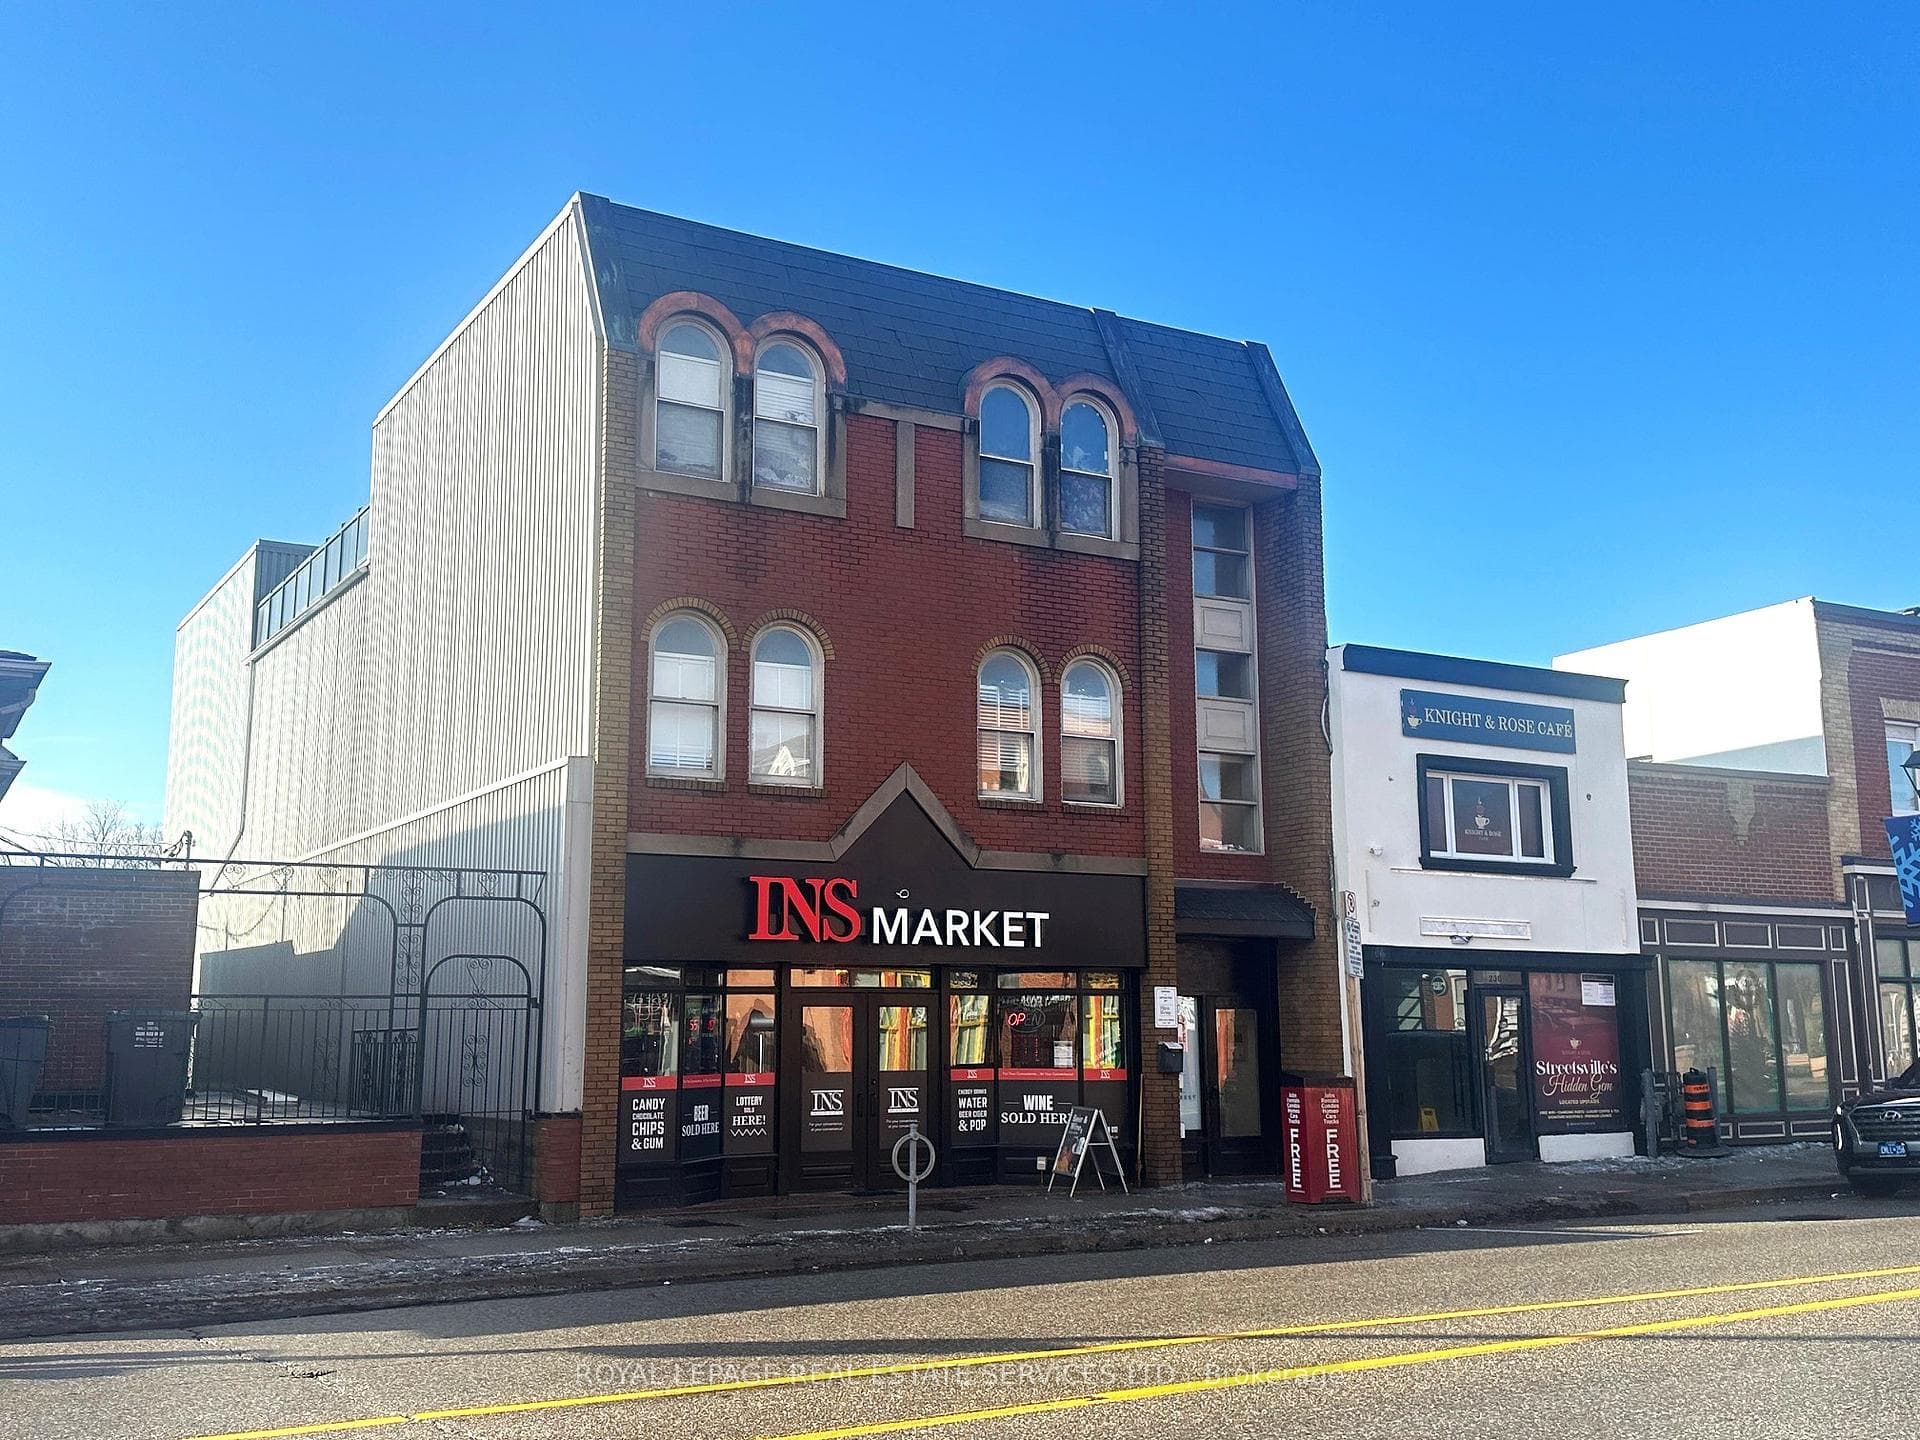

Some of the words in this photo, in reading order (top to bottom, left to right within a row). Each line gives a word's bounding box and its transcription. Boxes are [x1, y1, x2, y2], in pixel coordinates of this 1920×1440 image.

[1424, 708, 1482, 728] KNIGHT
[1485, 715, 1496, 730] &
[1498, 716, 1535, 734] ROSE
[1537, 720, 1573, 738] CAFÉ
[748, 876, 862, 943] INS
[872, 907, 1050, 948] MARKET
[1536, 1059, 1617, 1075] Streetsville's
[1542, 1073, 1587, 1096] Hidden
[1589, 1073, 1613, 1099] Gem
[632, 1098, 665, 1111] CANDY
[735, 1096, 763, 1106] LOTTERY
[812, 1092, 843, 1111] INS
[889, 1090, 918, 1109] INS
[958, 1097, 988, 1109] WATER
[1023, 1095, 1054, 1111] WINE
[632, 1112, 664, 1120] CHOCOLATE
[694, 1104, 709, 1121] BEER
[1000, 1112, 1037, 1124] SOLD
[1040, 1112, 1072, 1124] HER
[732, 1115, 766, 1126] HERE!
[958, 1120, 969, 1131] &
[970, 1119, 987, 1131] POP
[632, 1121, 664, 1136] CHIPS
[681, 1124, 701, 1136] SOLD
[701, 1122, 720, 1134] HERE
[631, 1138, 642, 1150] &
[643, 1137, 663, 1149] GUM
[1290, 1128, 1302, 1188] FREE
[1326, 1128, 1341, 1189] FREE
